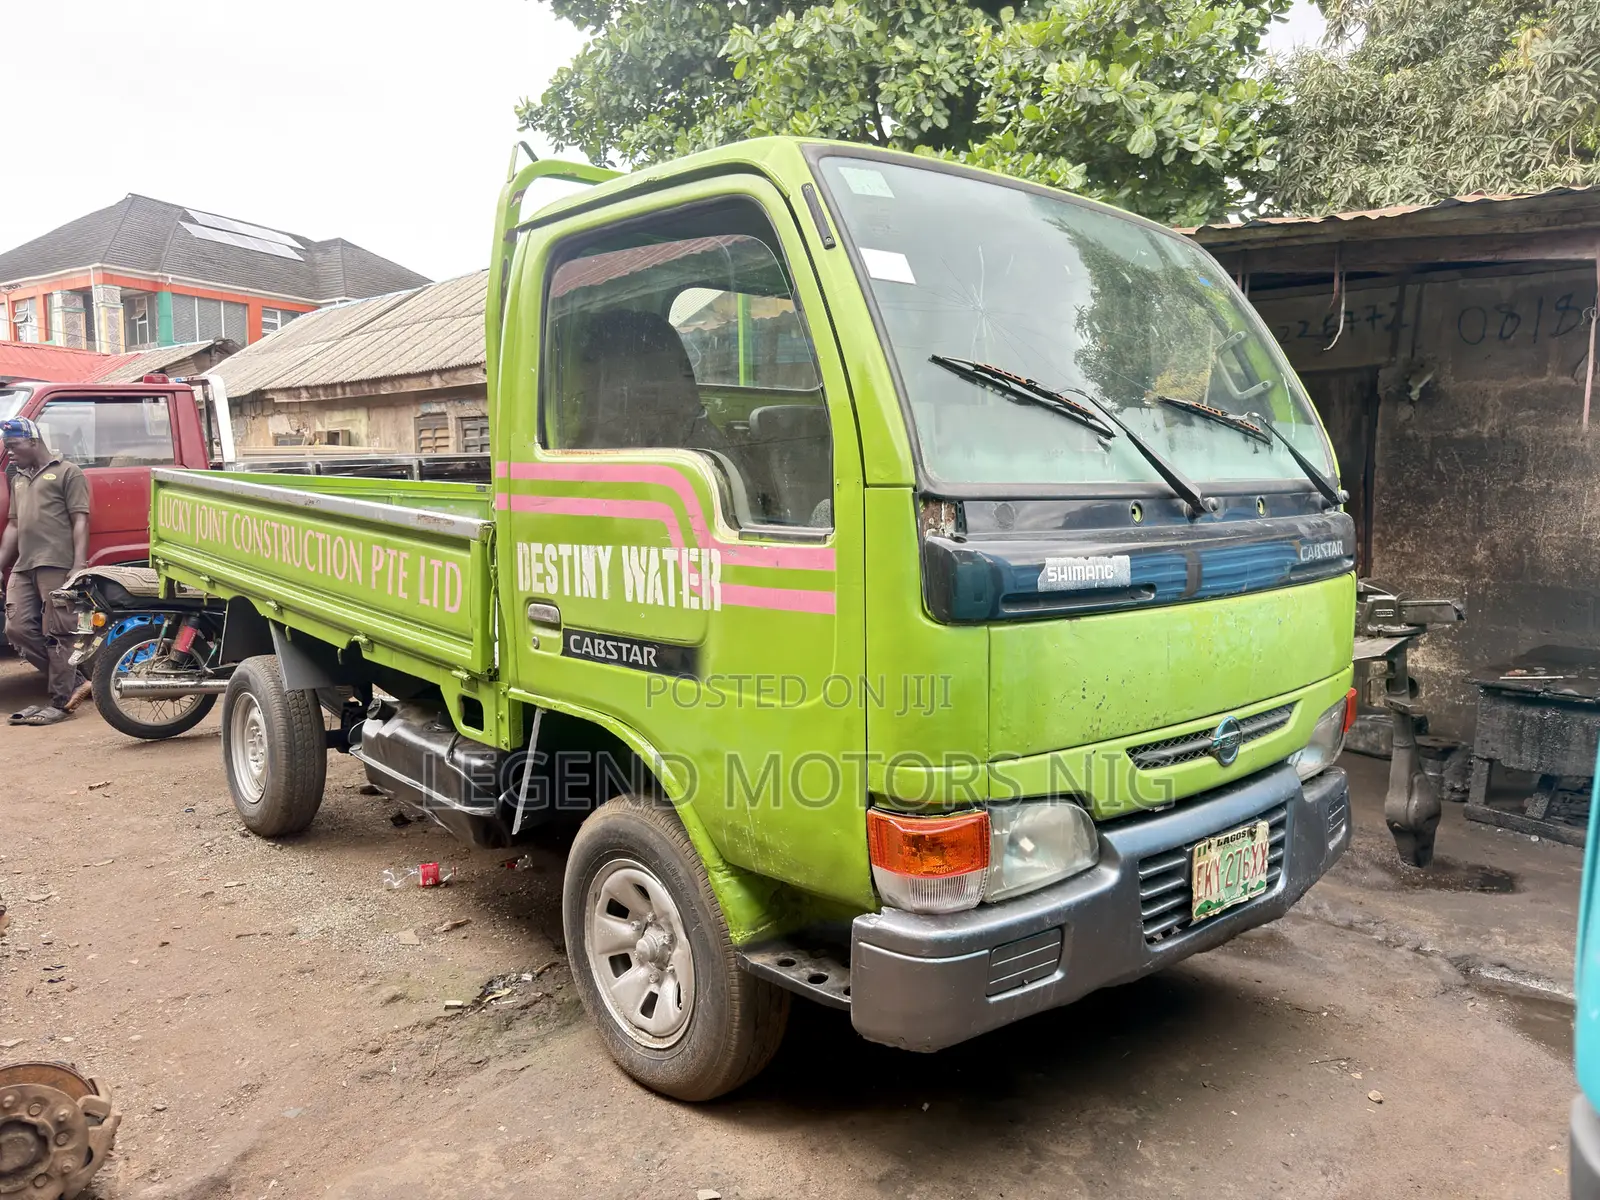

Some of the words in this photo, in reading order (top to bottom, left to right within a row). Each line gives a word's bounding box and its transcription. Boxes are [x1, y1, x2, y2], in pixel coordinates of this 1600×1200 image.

[1457, 290, 1599, 346] 0818
[158, 495, 193, 535] LUCKY
[195, 505, 228, 545] JOINT
[232, 513, 363, 587] CONSTRUCTION
[371, 544, 409, 599] PTE
[419, 555, 463, 613] LTD
[1300, 541, 1344, 562] CABSTAR
[517, 541, 613, 600] DESTINY
[621, 545, 722, 612] WATER
[569, 634, 658, 668] CABSTAR
[1216, 829, 1247, 847] LAGOS
